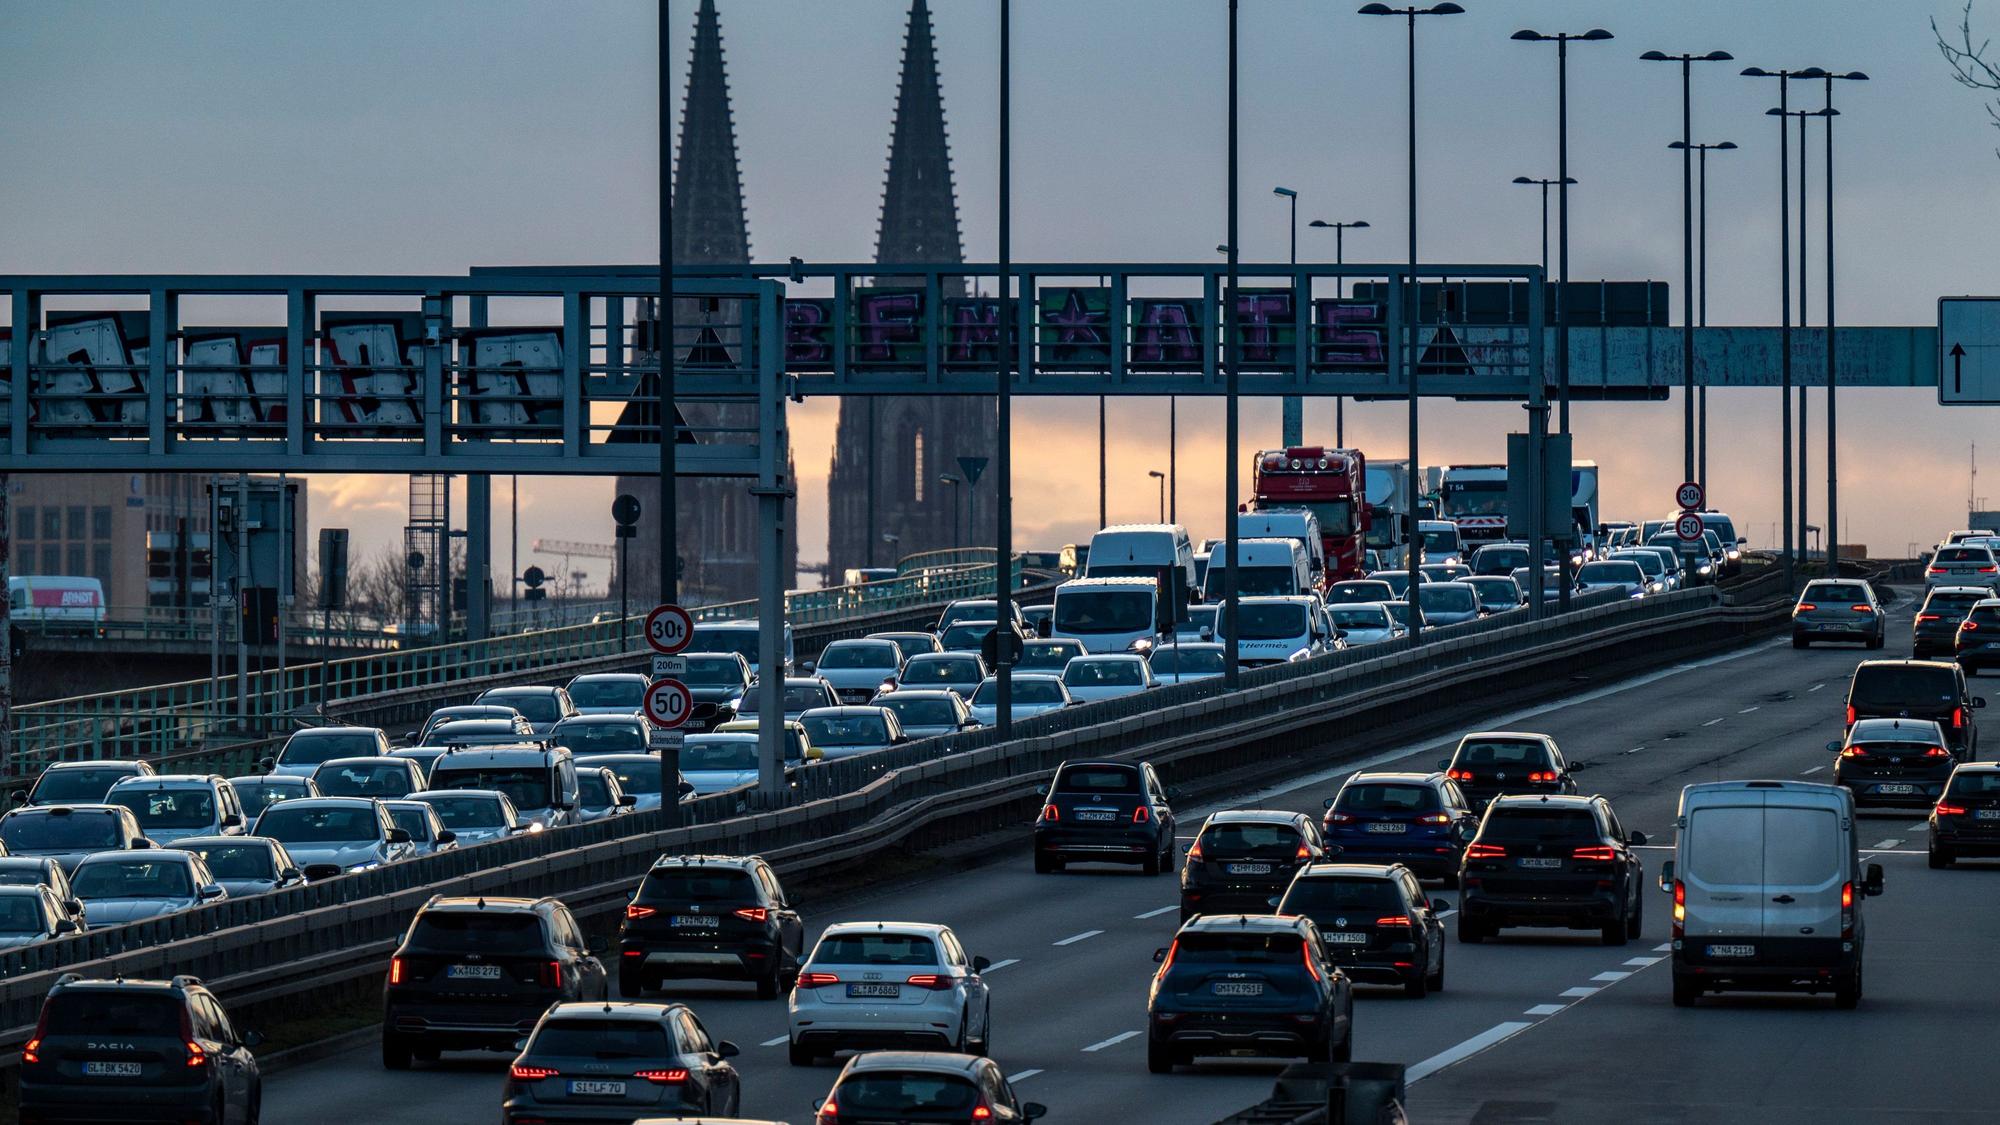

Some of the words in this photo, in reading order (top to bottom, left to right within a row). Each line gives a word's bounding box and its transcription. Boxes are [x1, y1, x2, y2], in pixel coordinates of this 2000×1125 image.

[1682, 489, 1699, 500] 30t
[1682, 521, 1698, 534] 50
[652, 620, 683, 639] 30t
[656, 661, 682, 670] 200m
[655, 692, 682, 715] 50
[88, 1042, 136, 1050] DACIA
